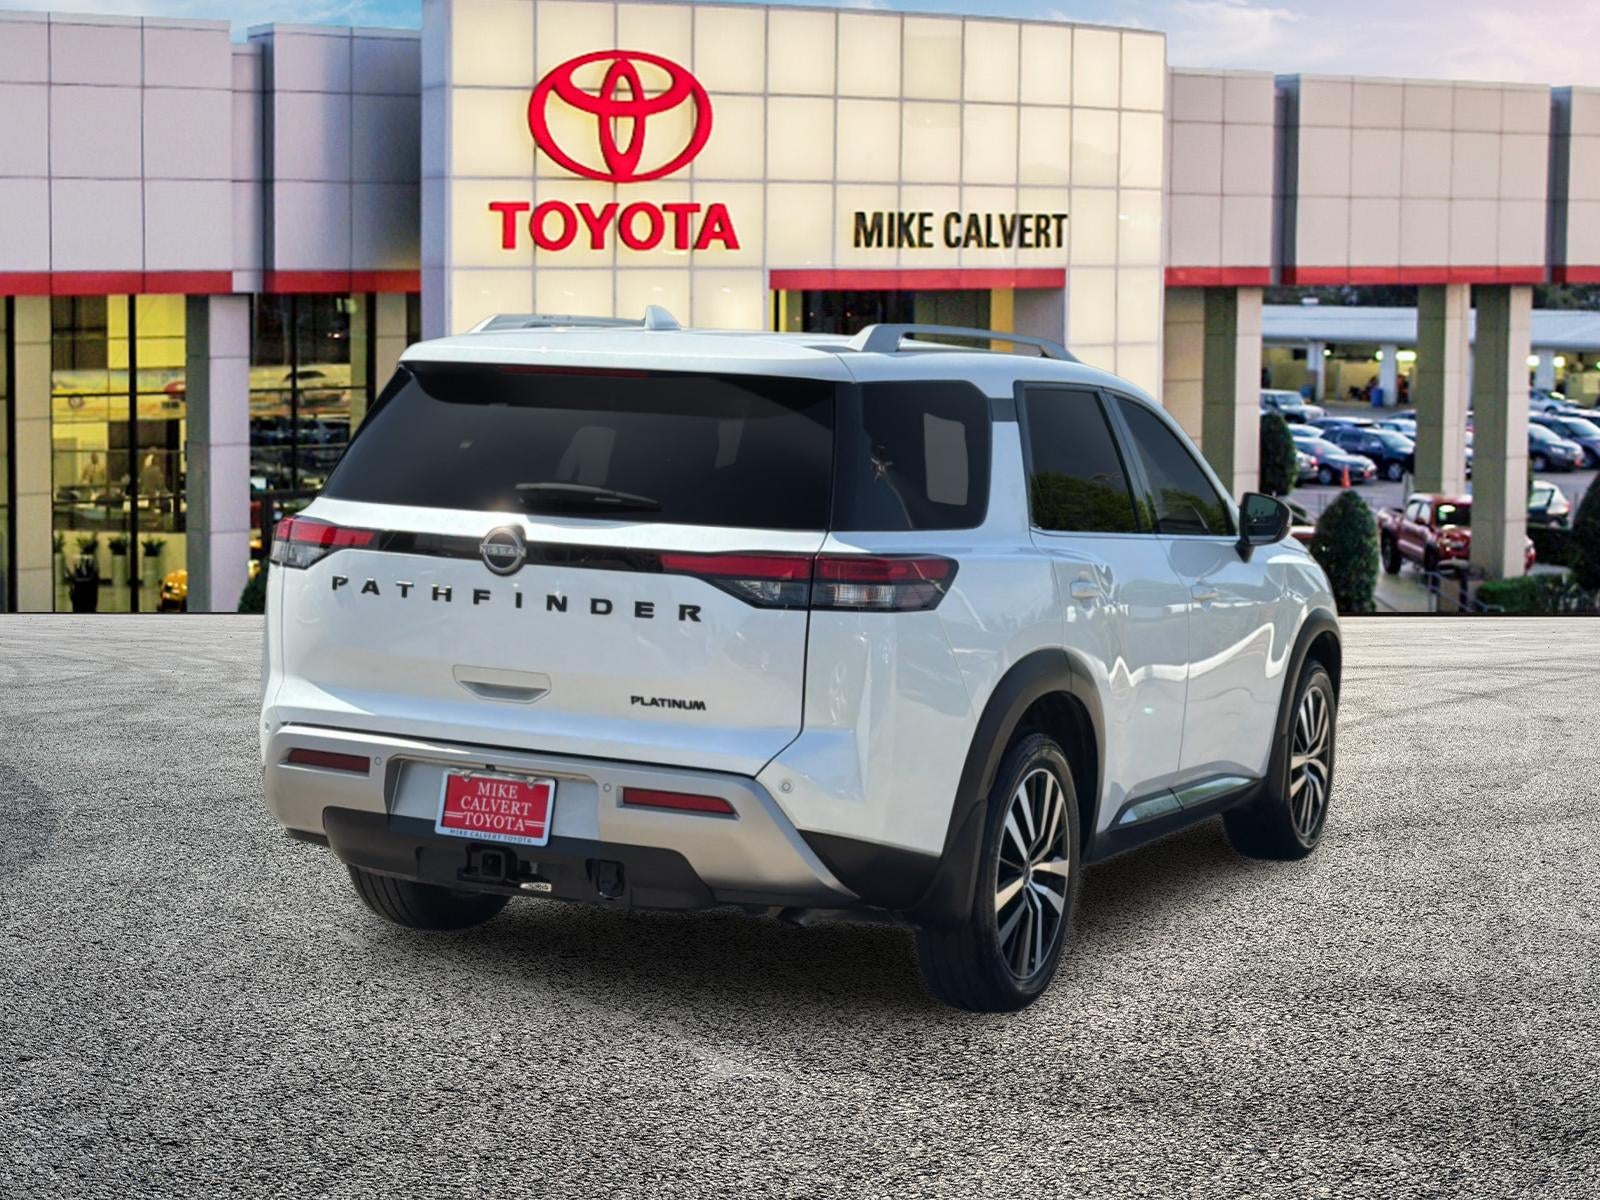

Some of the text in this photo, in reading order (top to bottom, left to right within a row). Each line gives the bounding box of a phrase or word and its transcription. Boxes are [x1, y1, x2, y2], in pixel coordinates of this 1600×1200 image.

[489, 200, 740, 251] TOYOTA
[854, 211, 1068, 248] MIKE CALVERT
[480, 543, 526, 557] NISSAN
[331, 575, 702, 623] PATHFINDER
[630, 695, 706, 711] PLATINUM
[477, 781, 518, 800] MIKE
[460, 795, 532, 816] CALVERT
[463, 811, 525, 832] TOYOTA
